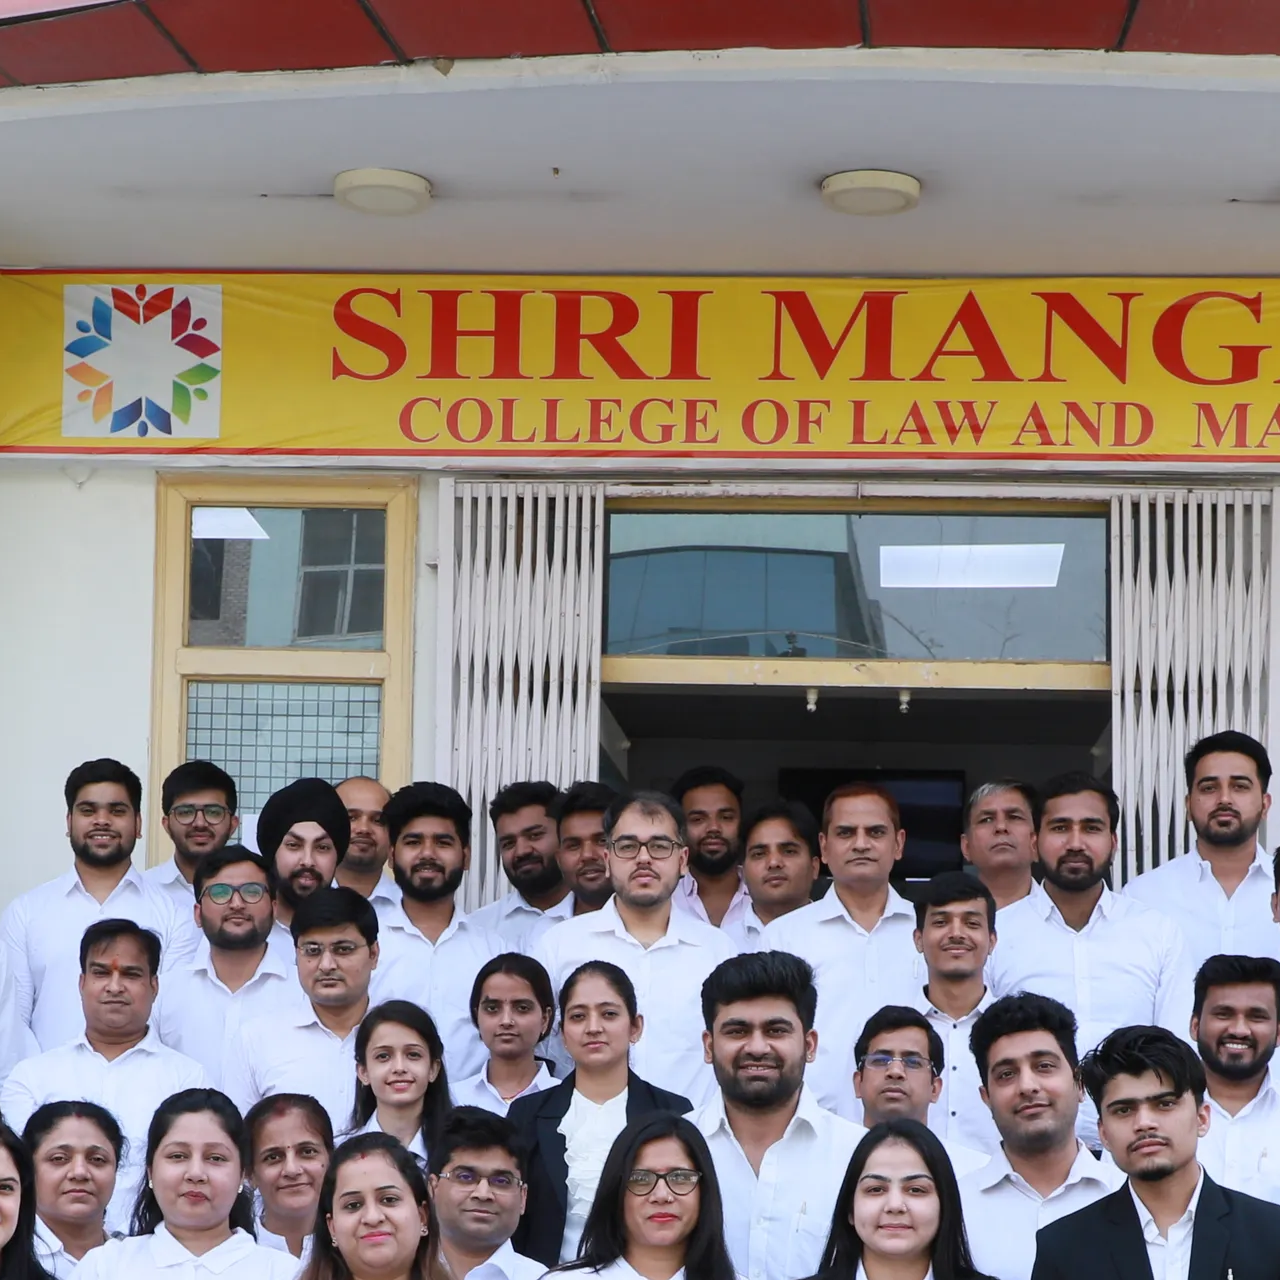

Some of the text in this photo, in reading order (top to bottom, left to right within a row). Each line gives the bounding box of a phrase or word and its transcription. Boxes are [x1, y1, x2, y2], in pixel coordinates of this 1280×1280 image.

[331, 287, 714, 381] SHRI
[398, 396, 720, 445] COLLEGE
[740, 398, 831, 445] OF
[848, 399, 998, 446] LAW
[1009, 400, 1155, 448] AND
